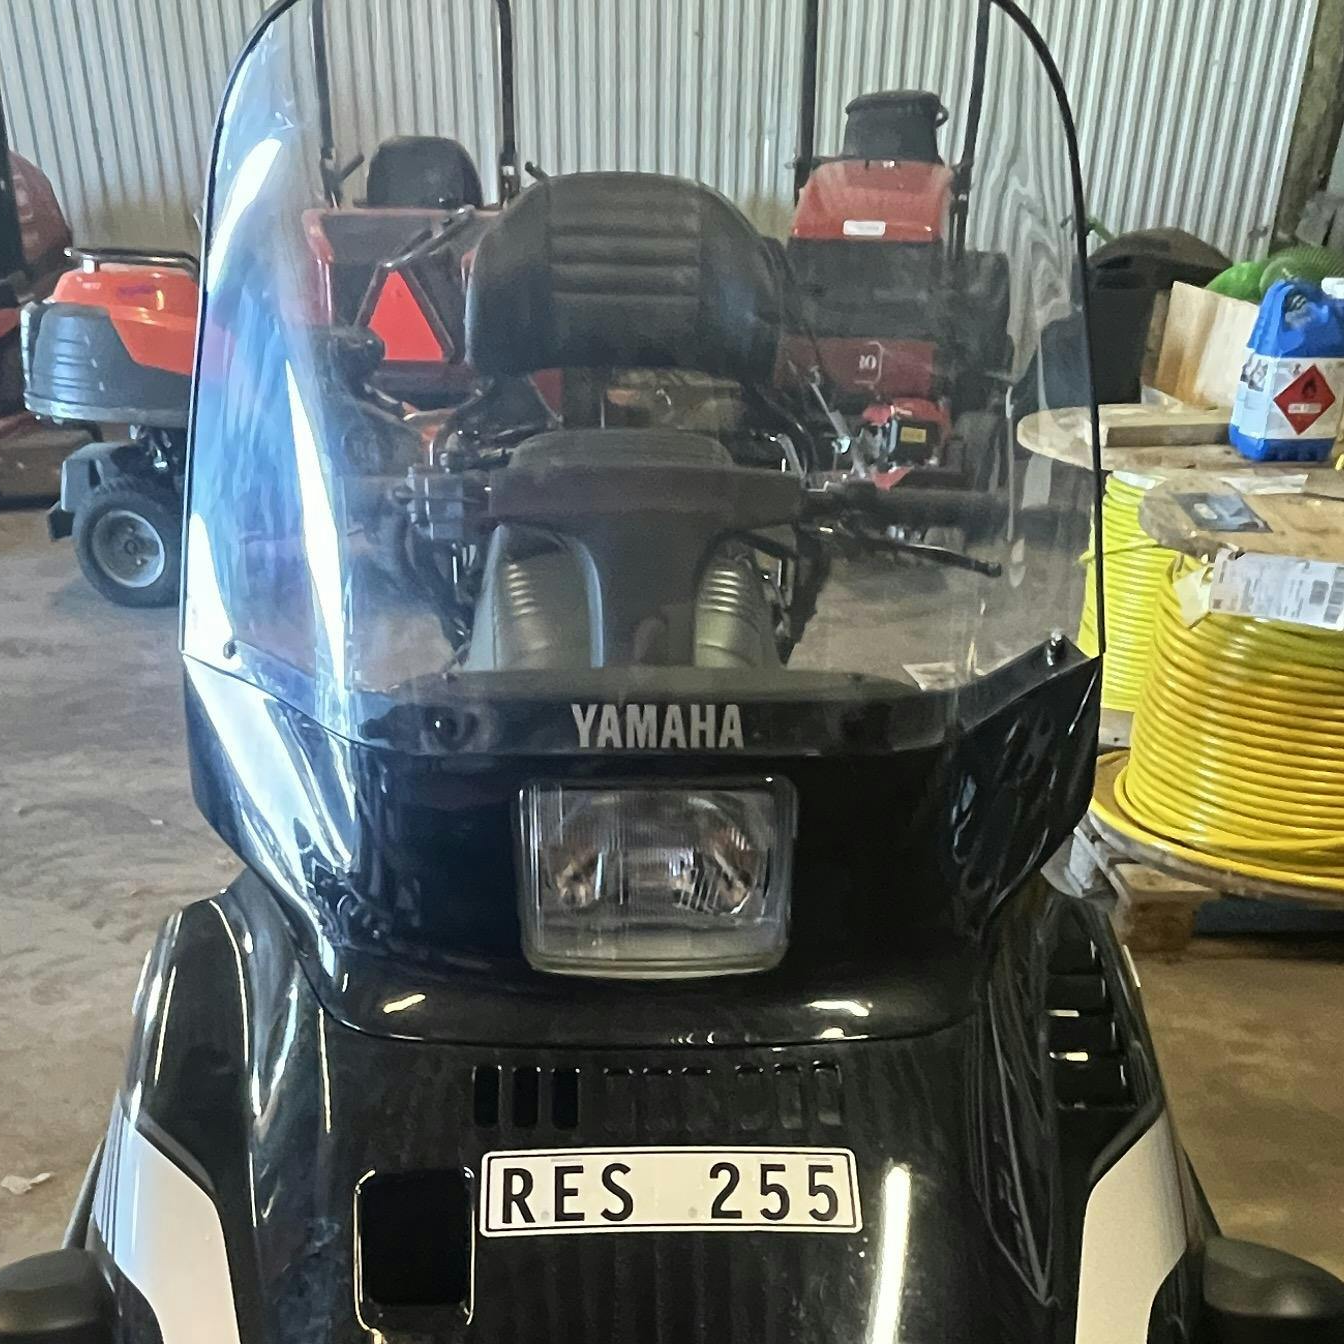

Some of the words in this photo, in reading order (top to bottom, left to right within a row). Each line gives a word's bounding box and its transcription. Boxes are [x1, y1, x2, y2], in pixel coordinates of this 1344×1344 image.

[571, 703, 745, 749] YAMAHA
[502, 1162, 634, 1224] RES
[709, 1162, 839, 1222] 255
